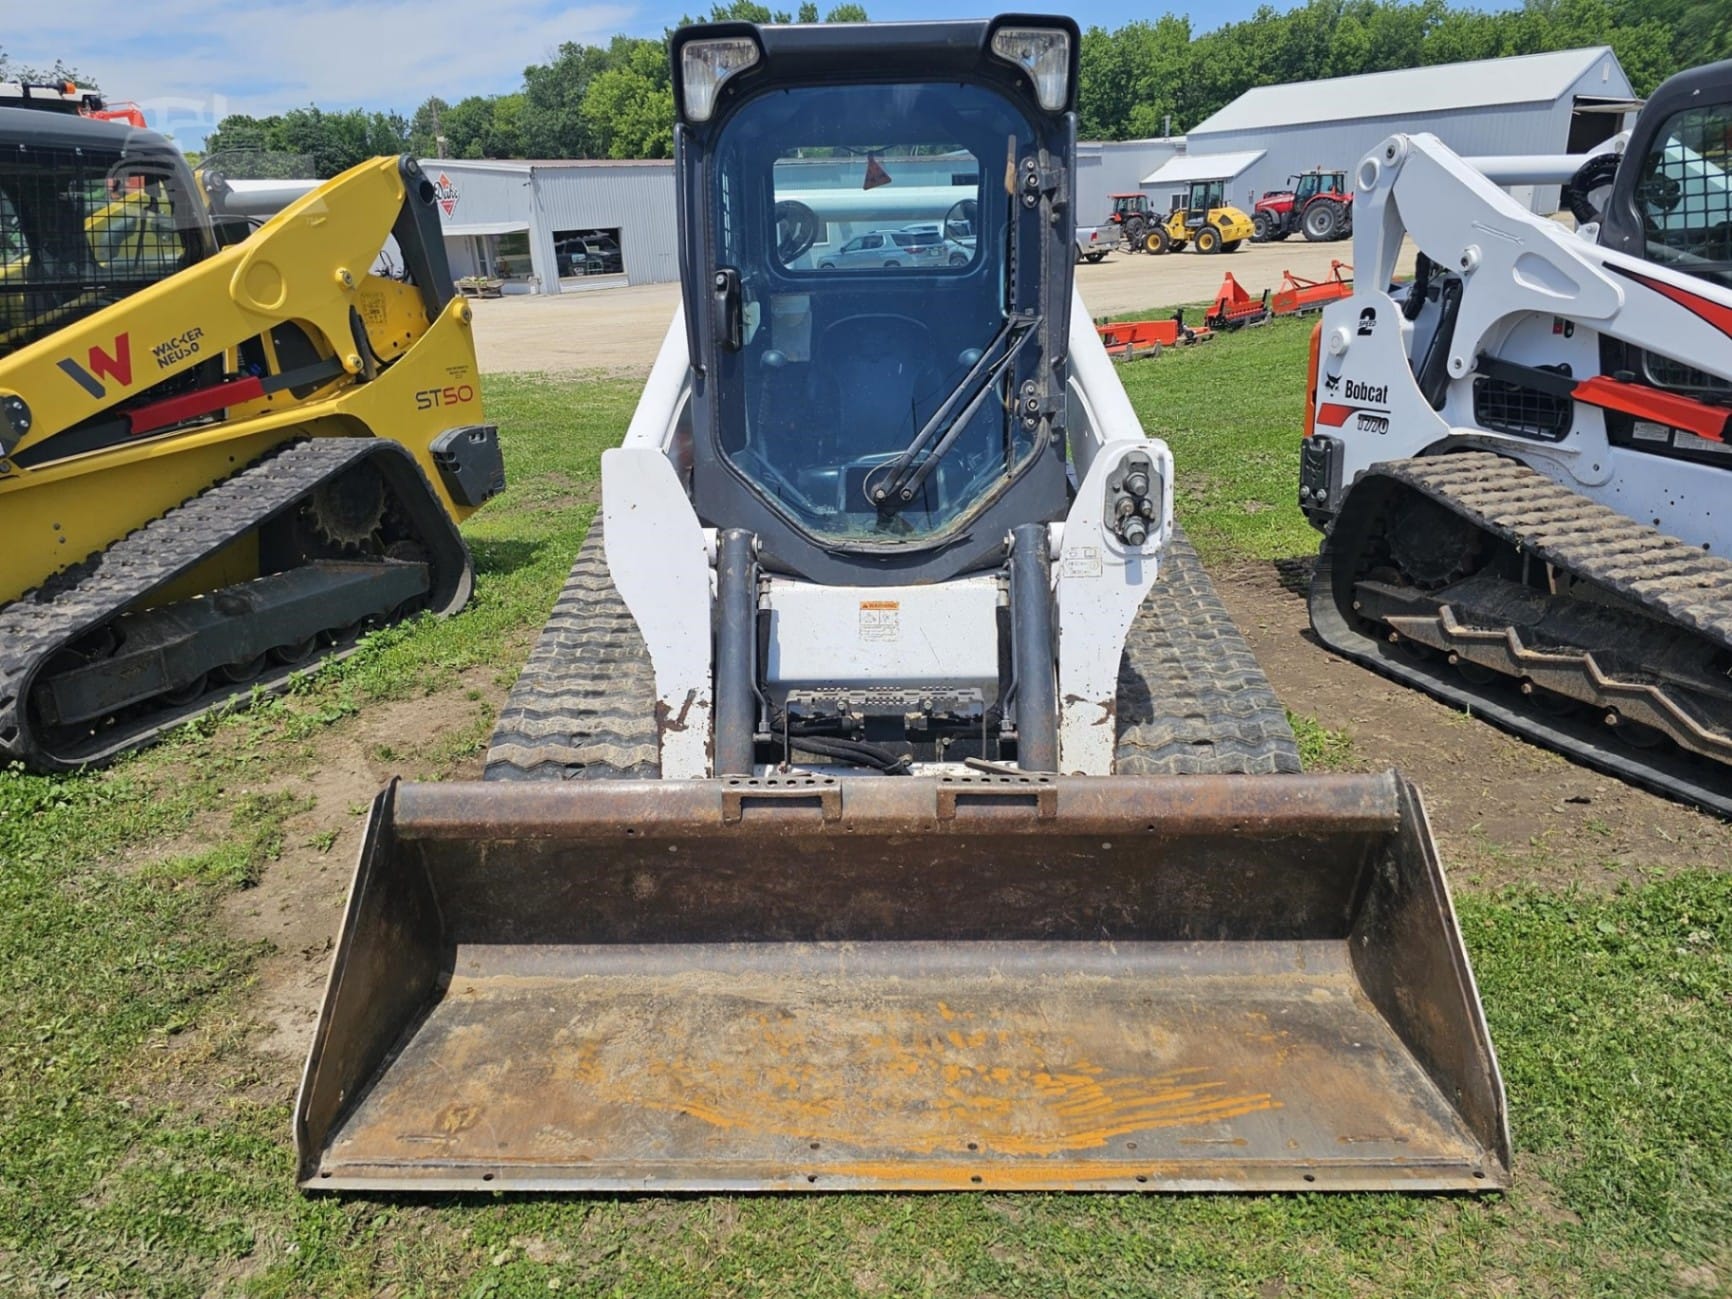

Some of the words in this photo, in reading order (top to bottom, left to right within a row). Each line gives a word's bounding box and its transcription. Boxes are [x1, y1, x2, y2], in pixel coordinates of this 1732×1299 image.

[152, 327, 204, 357] WACKER
[415, 385, 473, 410] ST50
[1345, 379, 1388, 404] Bobcat
[1357, 413, 1390, 435] T770
